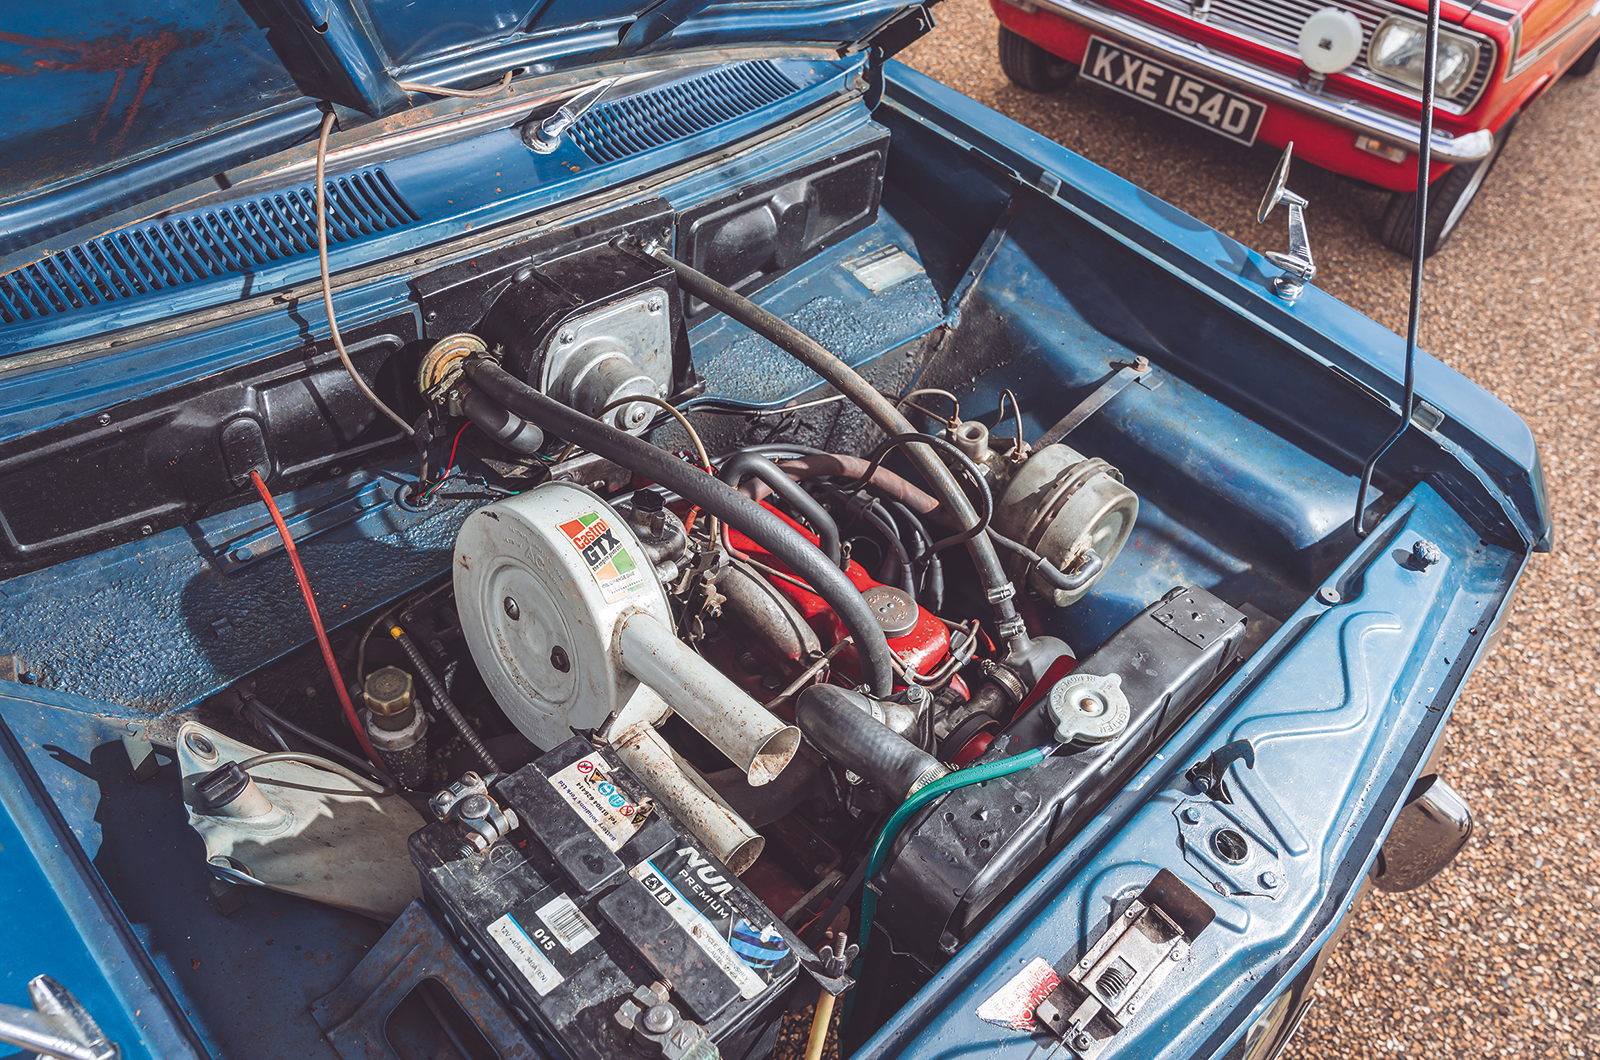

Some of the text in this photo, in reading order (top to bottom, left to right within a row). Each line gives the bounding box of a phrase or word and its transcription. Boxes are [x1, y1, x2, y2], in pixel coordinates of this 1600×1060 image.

[1092, 45, 1251, 135] KXE 154D
[572, 518, 610, 550] Castrol
[582, 527, 621, 567] GTX
[1060, 676, 1096, 687] REMOVE
[558, 779, 617, 842] Battery Solutions York Ltd
[593, 801, 608, 817] 01904
[608, 814, 618, 825] Tel.
[678, 869, 730, 919] PREMIUM
[534, 928, 556, 951] 015
[697, 922, 719, 952] RECYCLE
[500, 925, 511, 937] 12V
[534, 970, 548, 984] (EN)
